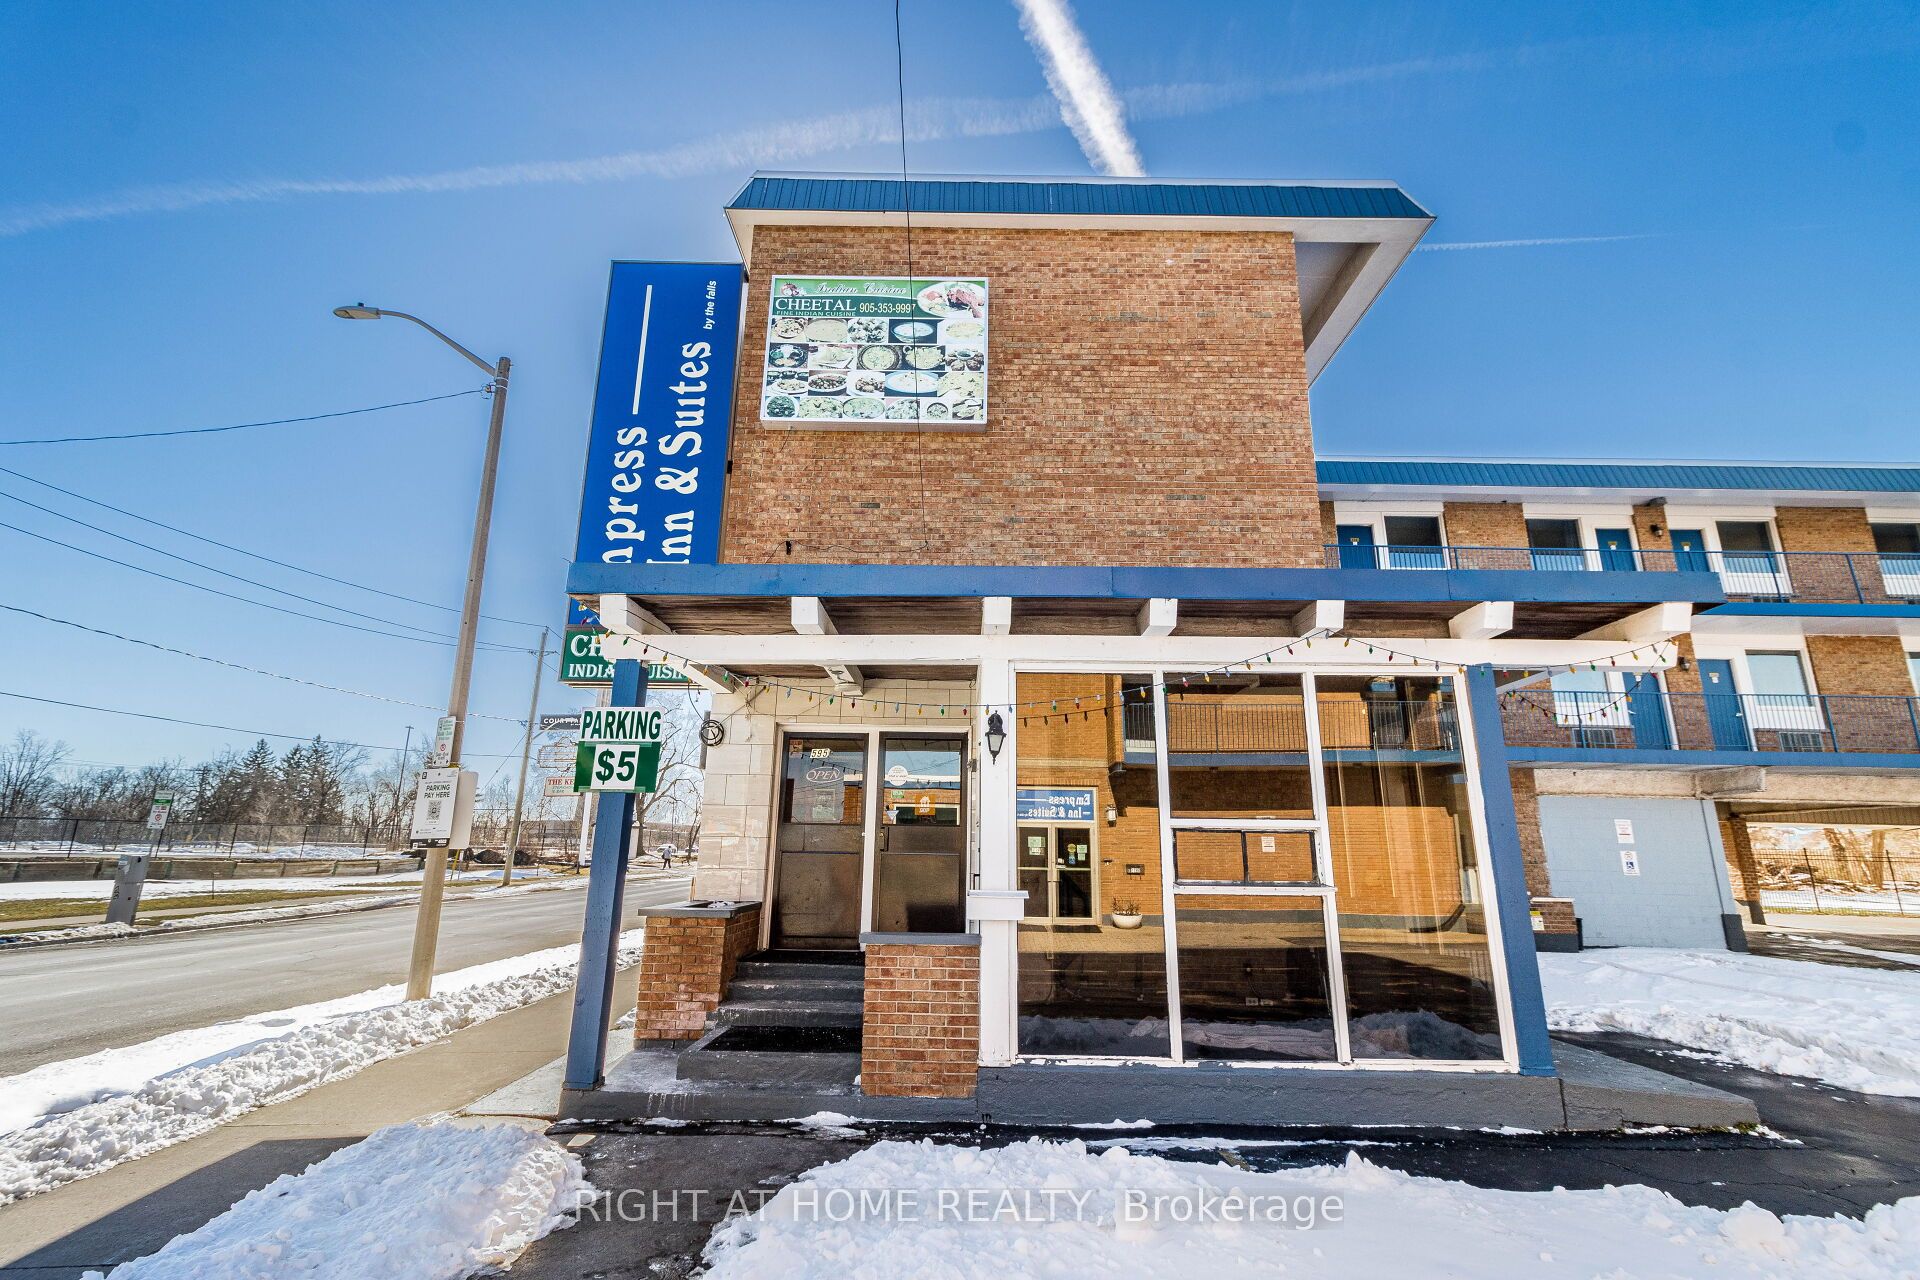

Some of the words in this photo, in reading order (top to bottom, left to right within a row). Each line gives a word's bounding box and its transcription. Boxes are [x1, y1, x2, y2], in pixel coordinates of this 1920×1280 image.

[706, 280, 717, 299] falls
[815, 282, 858, 294] Indian
[863, 282, 907, 294] Cuisine
[705, 299, 715, 316] the
[775, 298, 857, 311] CHEETAL
[859, 302, 916, 314] 905-353-9997
[704, 317, 715, 330] by
[658, 341, 712, 457] Suites
[655, 467, 698, 494] &
[568, 663, 615, 678] INDIA
[581, 710, 662, 740] PARKING
[812, 749, 828, 757] 595
[595, 748, 637, 785] $5
[548, 778, 563, 786] THE
[807, 769, 839, 781] OPEN
